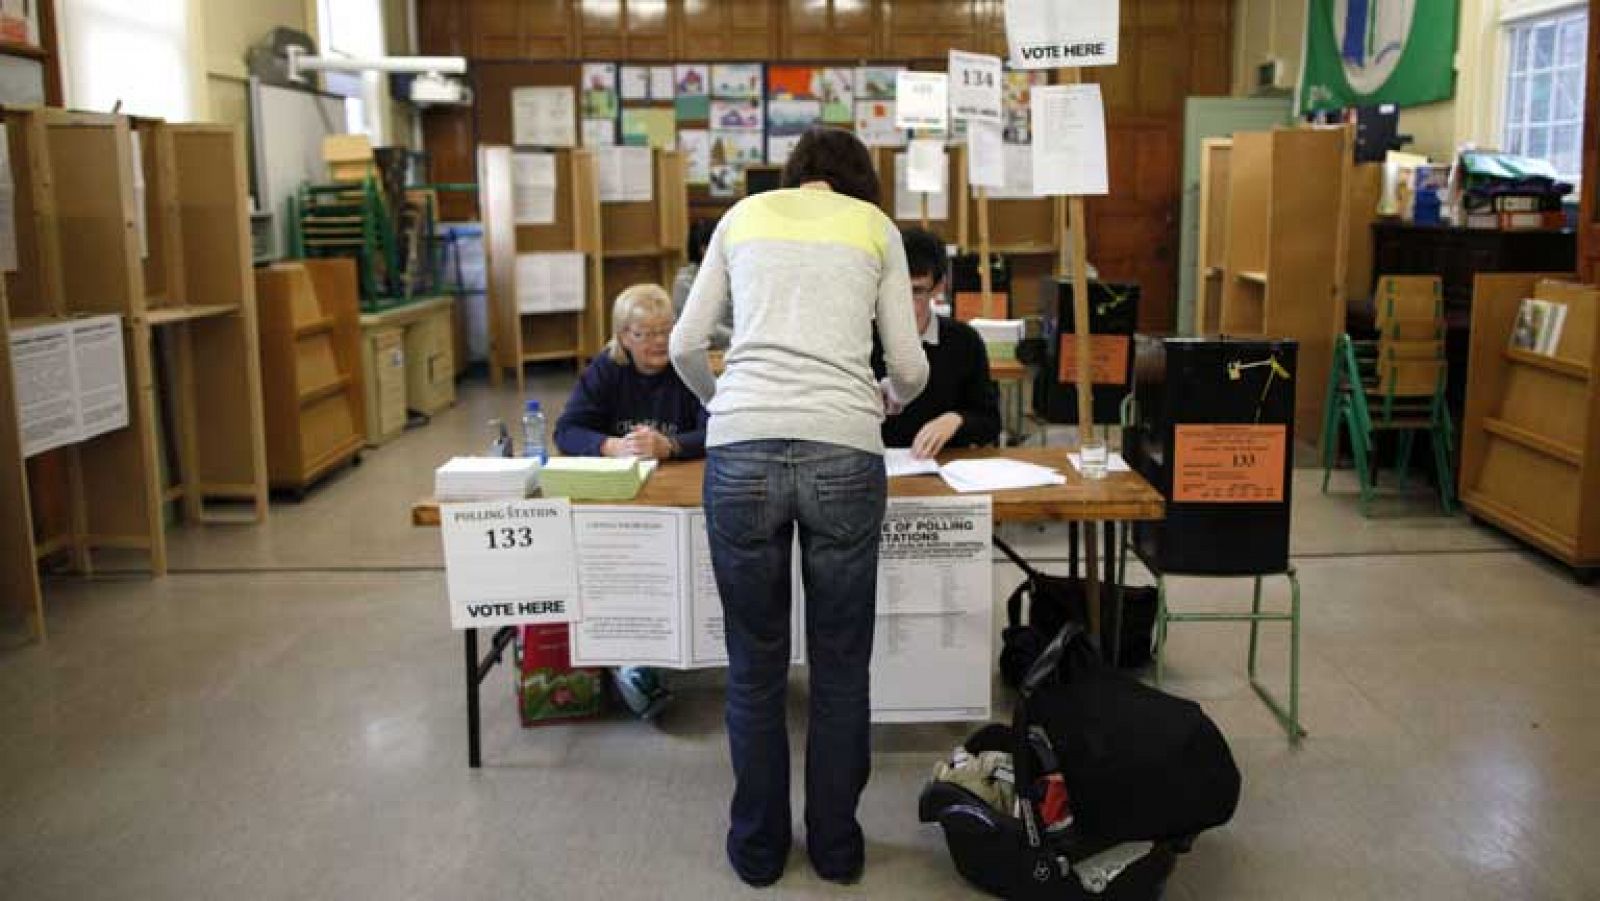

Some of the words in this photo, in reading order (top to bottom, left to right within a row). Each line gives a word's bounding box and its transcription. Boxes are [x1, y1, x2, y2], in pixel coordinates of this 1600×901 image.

[1021, 45, 1060, 59] VOTE
[1063, 41, 1105, 57] HERE
[963, 68, 994, 88] 134
[1232, 453, 1256, 468] 133
[454, 509, 504, 521] POLLING
[508, 506, 557, 518] STATION
[916, 520, 973, 531] POLLING
[486, 526, 533, 549] 133
[466, 602, 514, 617] VOTE
[518, 600, 566, 615] HERE
